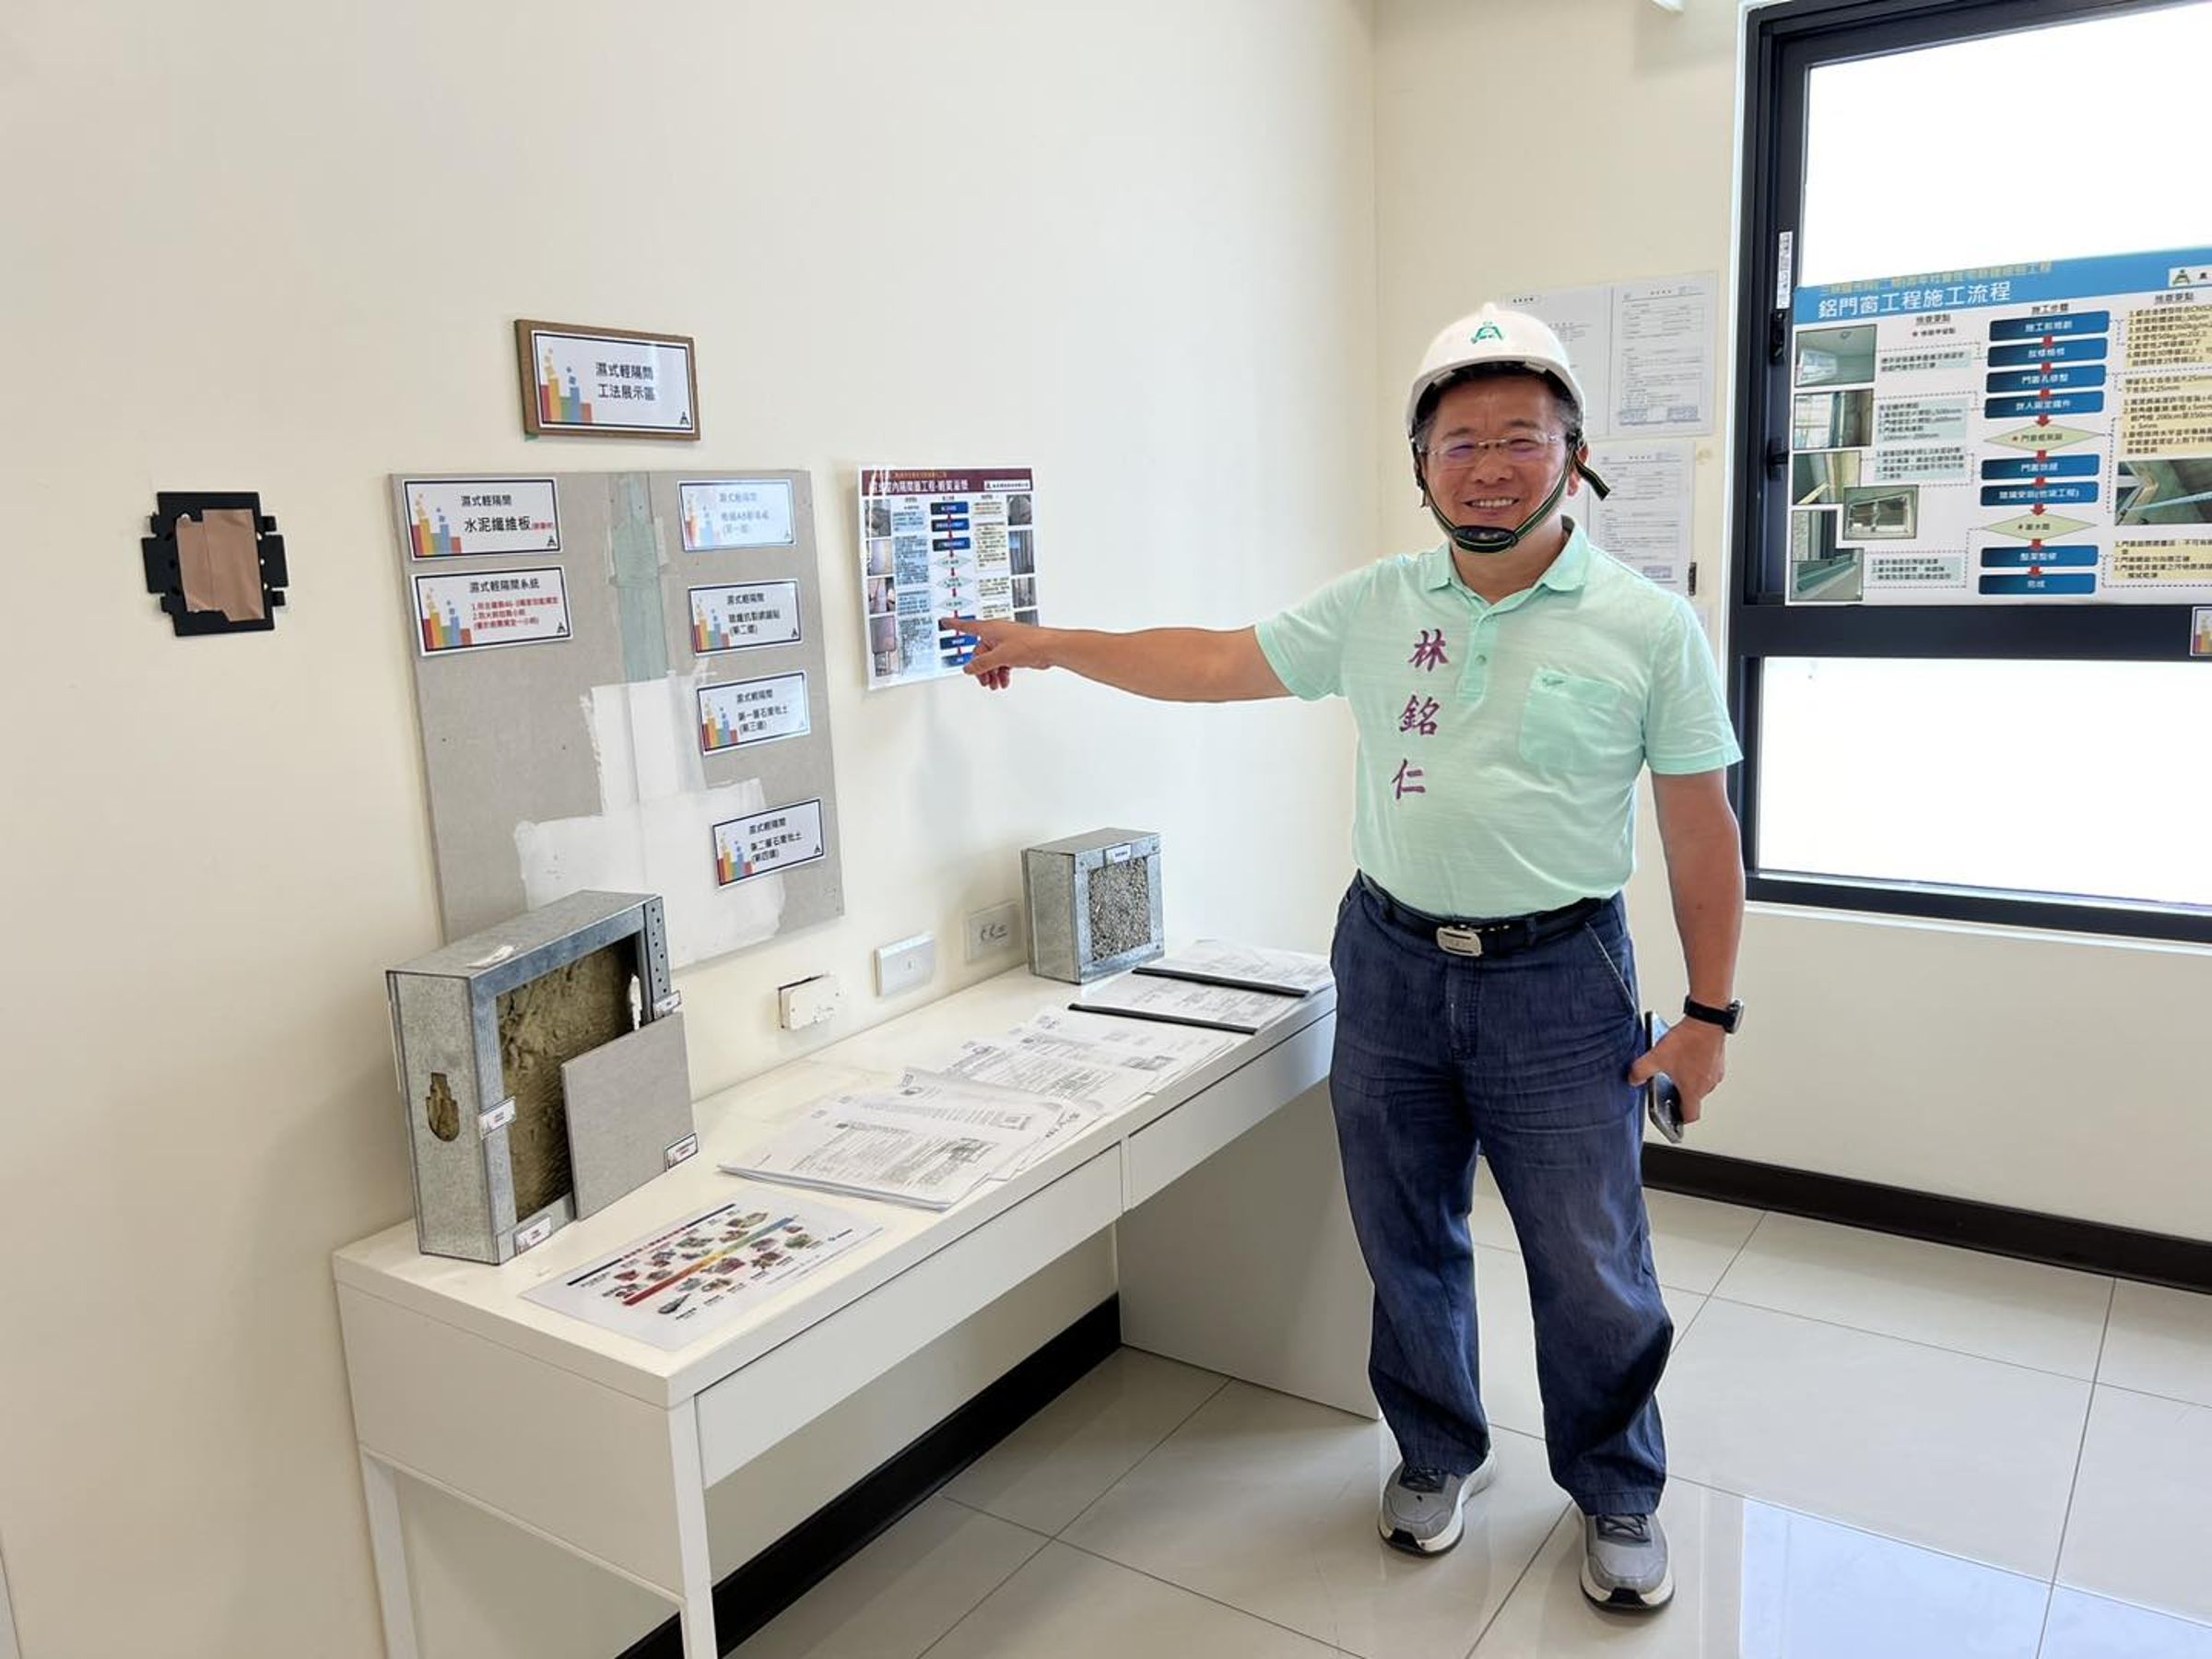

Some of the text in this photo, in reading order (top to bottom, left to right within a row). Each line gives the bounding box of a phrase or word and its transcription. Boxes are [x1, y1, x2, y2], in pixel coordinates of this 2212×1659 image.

[1818, 281, 2010, 319] 鋁門窗工程施工流程
[595, 362, 654, 381] 濕式輕隔間
[598, 384, 656, 401] 工法展示區
[461, 495, 512, 507] 濕式輕隔間
[465, 516, 531, 532] 水泥纖維板
[1392, 629, 1449, 800] 林銘仁
